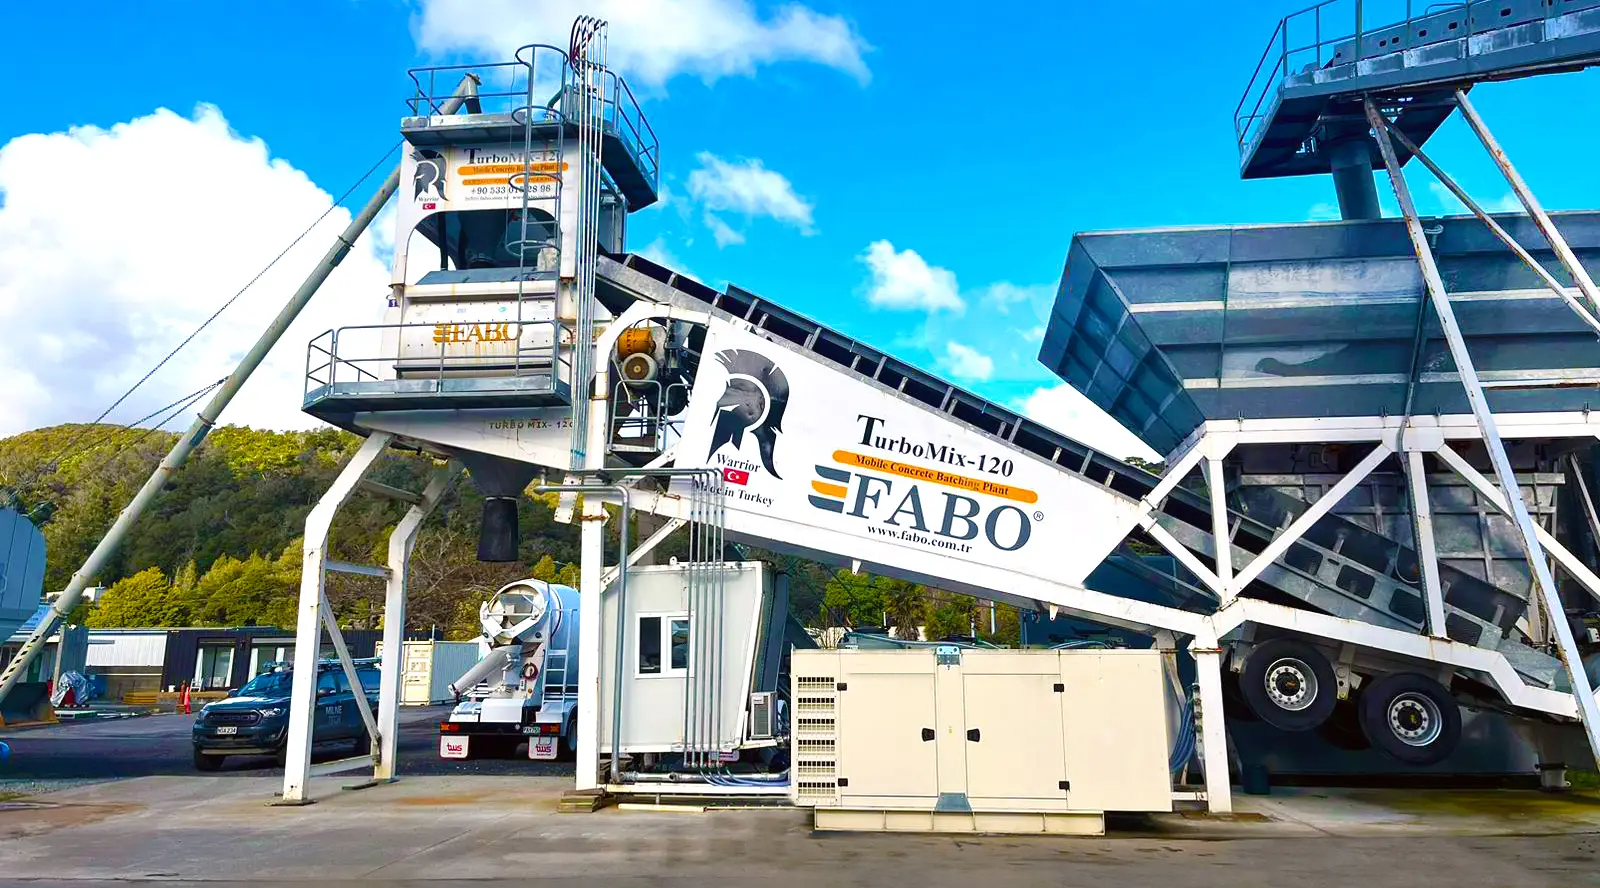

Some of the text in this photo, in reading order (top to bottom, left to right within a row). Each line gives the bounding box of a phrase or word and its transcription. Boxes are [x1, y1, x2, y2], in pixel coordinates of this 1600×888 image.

[464, 147, 562, 164] TurboMx-12
[856, 414, 1014, 478] TurboMix-120
[717, 453, 761, 473] Warrior
[855, 454, 1009, 496] Mobile Concrete Batching Plant
[725, 486, 735, 498] in
[738, 489, 774, 508] Turkey
[846, 473, 1032, 551] FABO
[867, 524, 973, 553] www.fabo.com.tr
